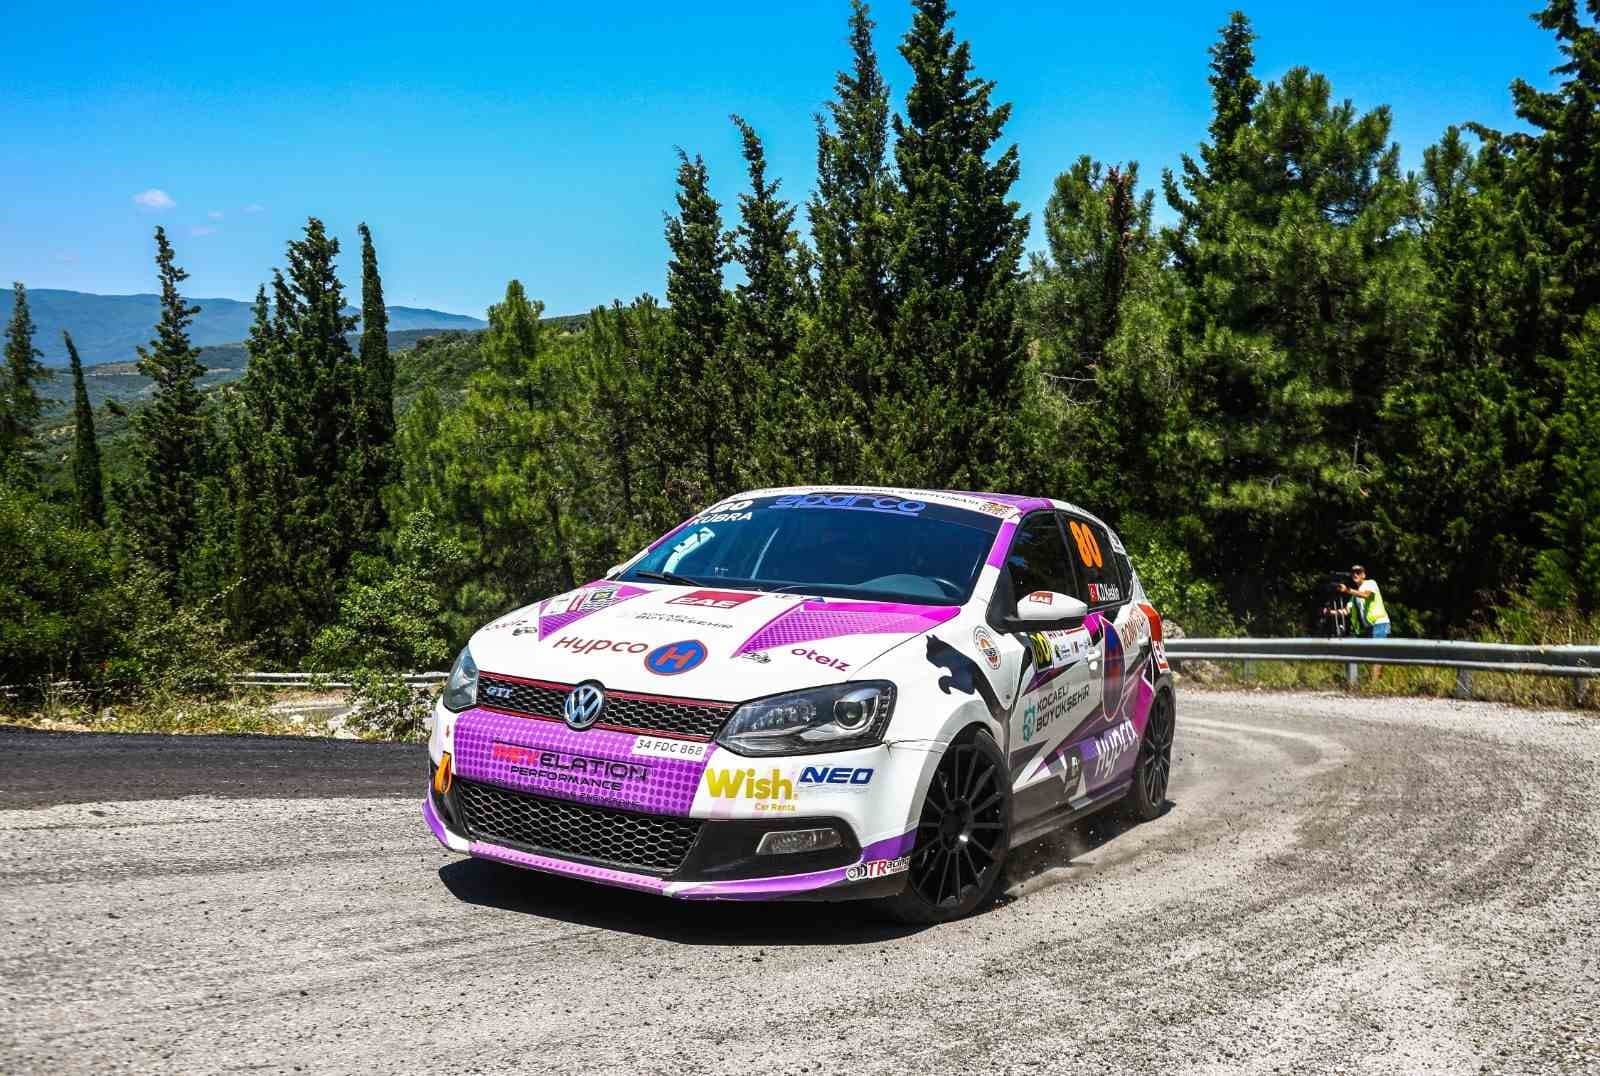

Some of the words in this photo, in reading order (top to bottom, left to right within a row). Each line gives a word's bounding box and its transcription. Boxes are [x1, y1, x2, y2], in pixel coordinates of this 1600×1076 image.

[775, 495, 927, 513] sparco
[1068, 520, 1104, 568] 80
[552, 636, 648, 655] Hypco
[791, 648, 851, 672] otelz
[635, 739, 651, 750] 34
[653, 740, 678, 753] FDC
[679, 744, 704, 756] 868
[510, 765, 623, 791] PERFORMANCE
[799, 766, 874, 785] NEO
